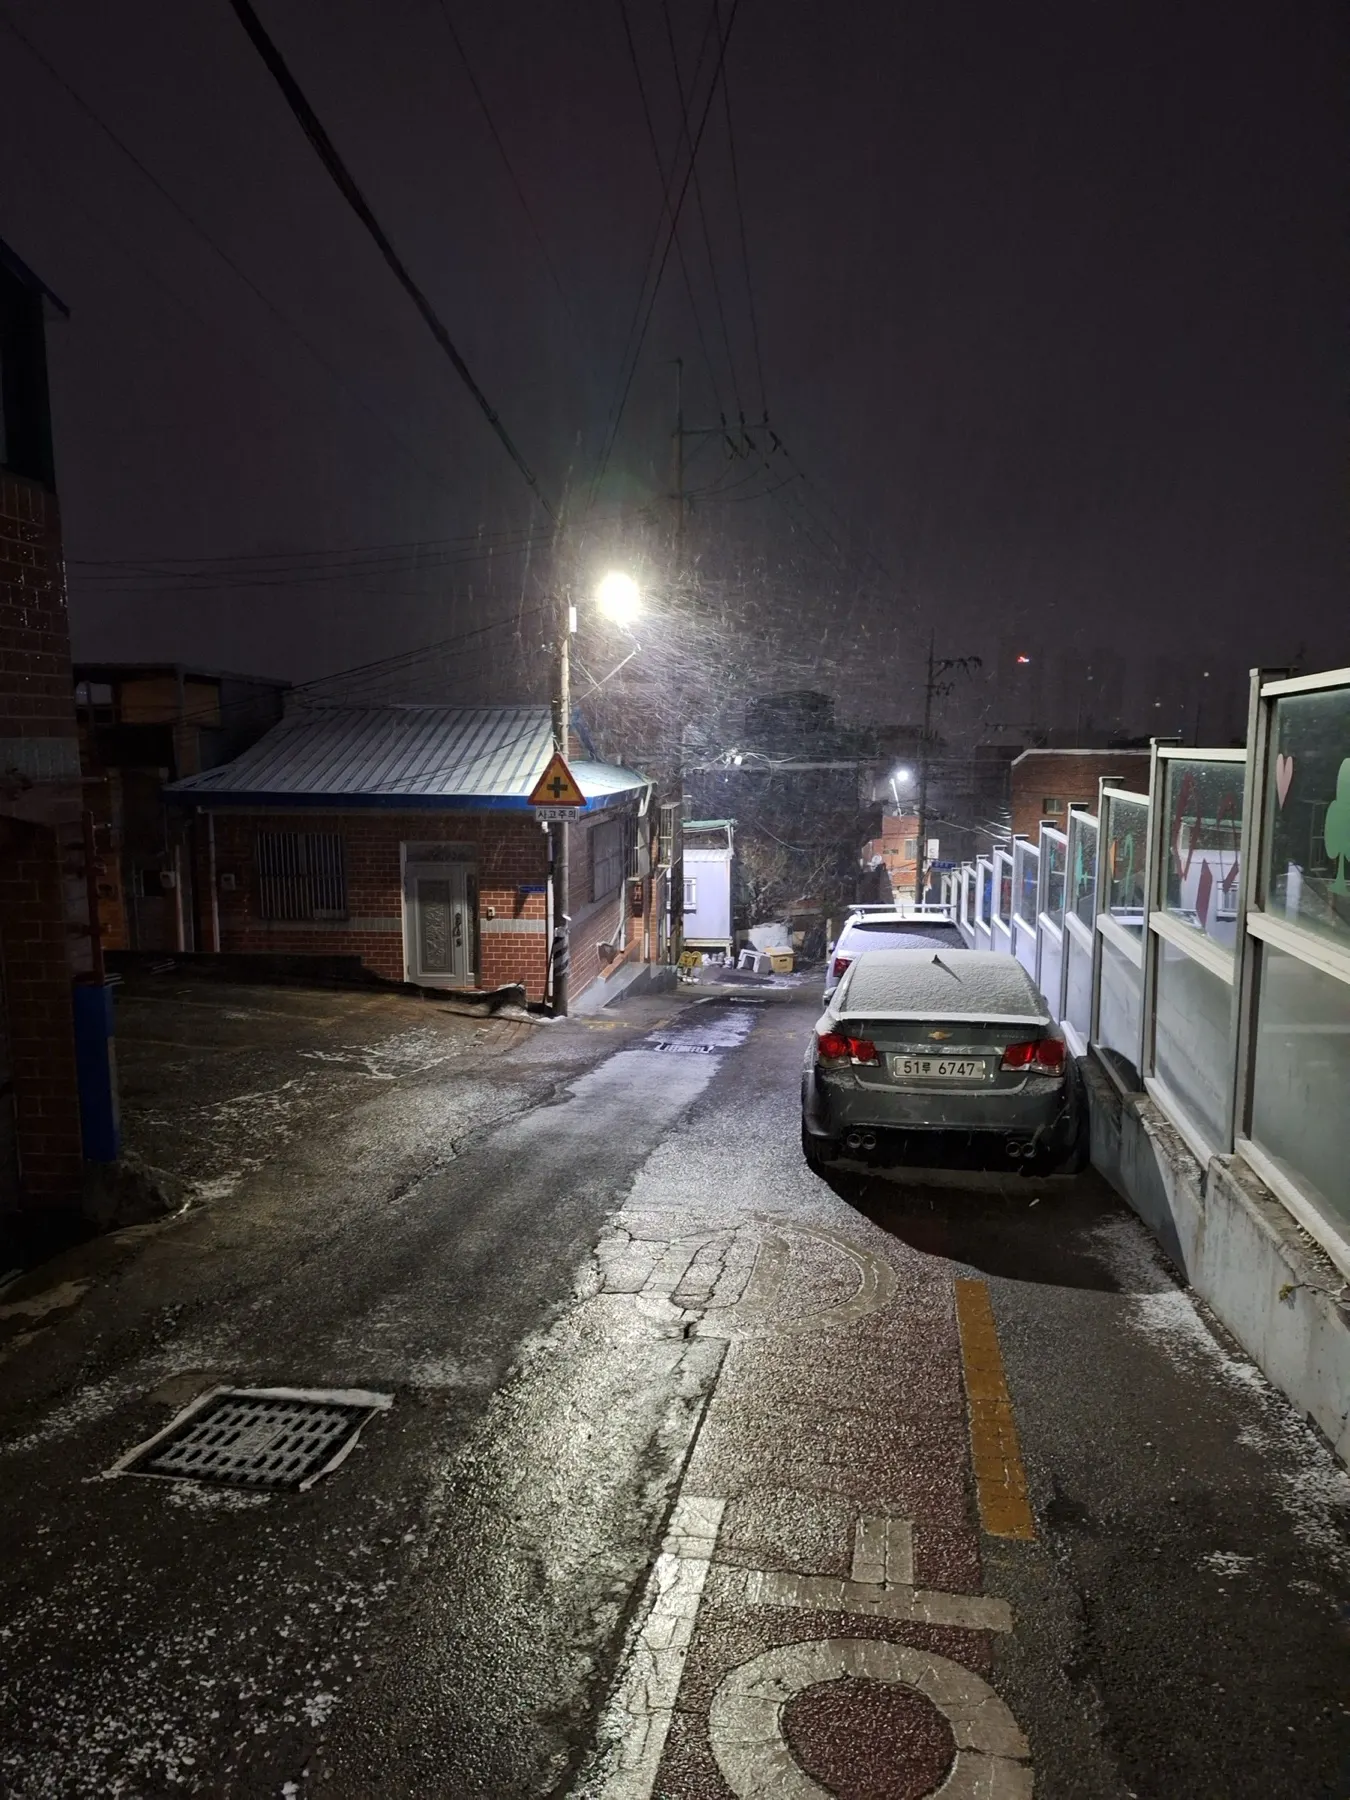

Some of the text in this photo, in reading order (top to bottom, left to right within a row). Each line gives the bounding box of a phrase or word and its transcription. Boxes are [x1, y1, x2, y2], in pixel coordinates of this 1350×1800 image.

[538, 810, 576, 819] 사고주의
[903, 1060, 976, 1076] 51루 6747
